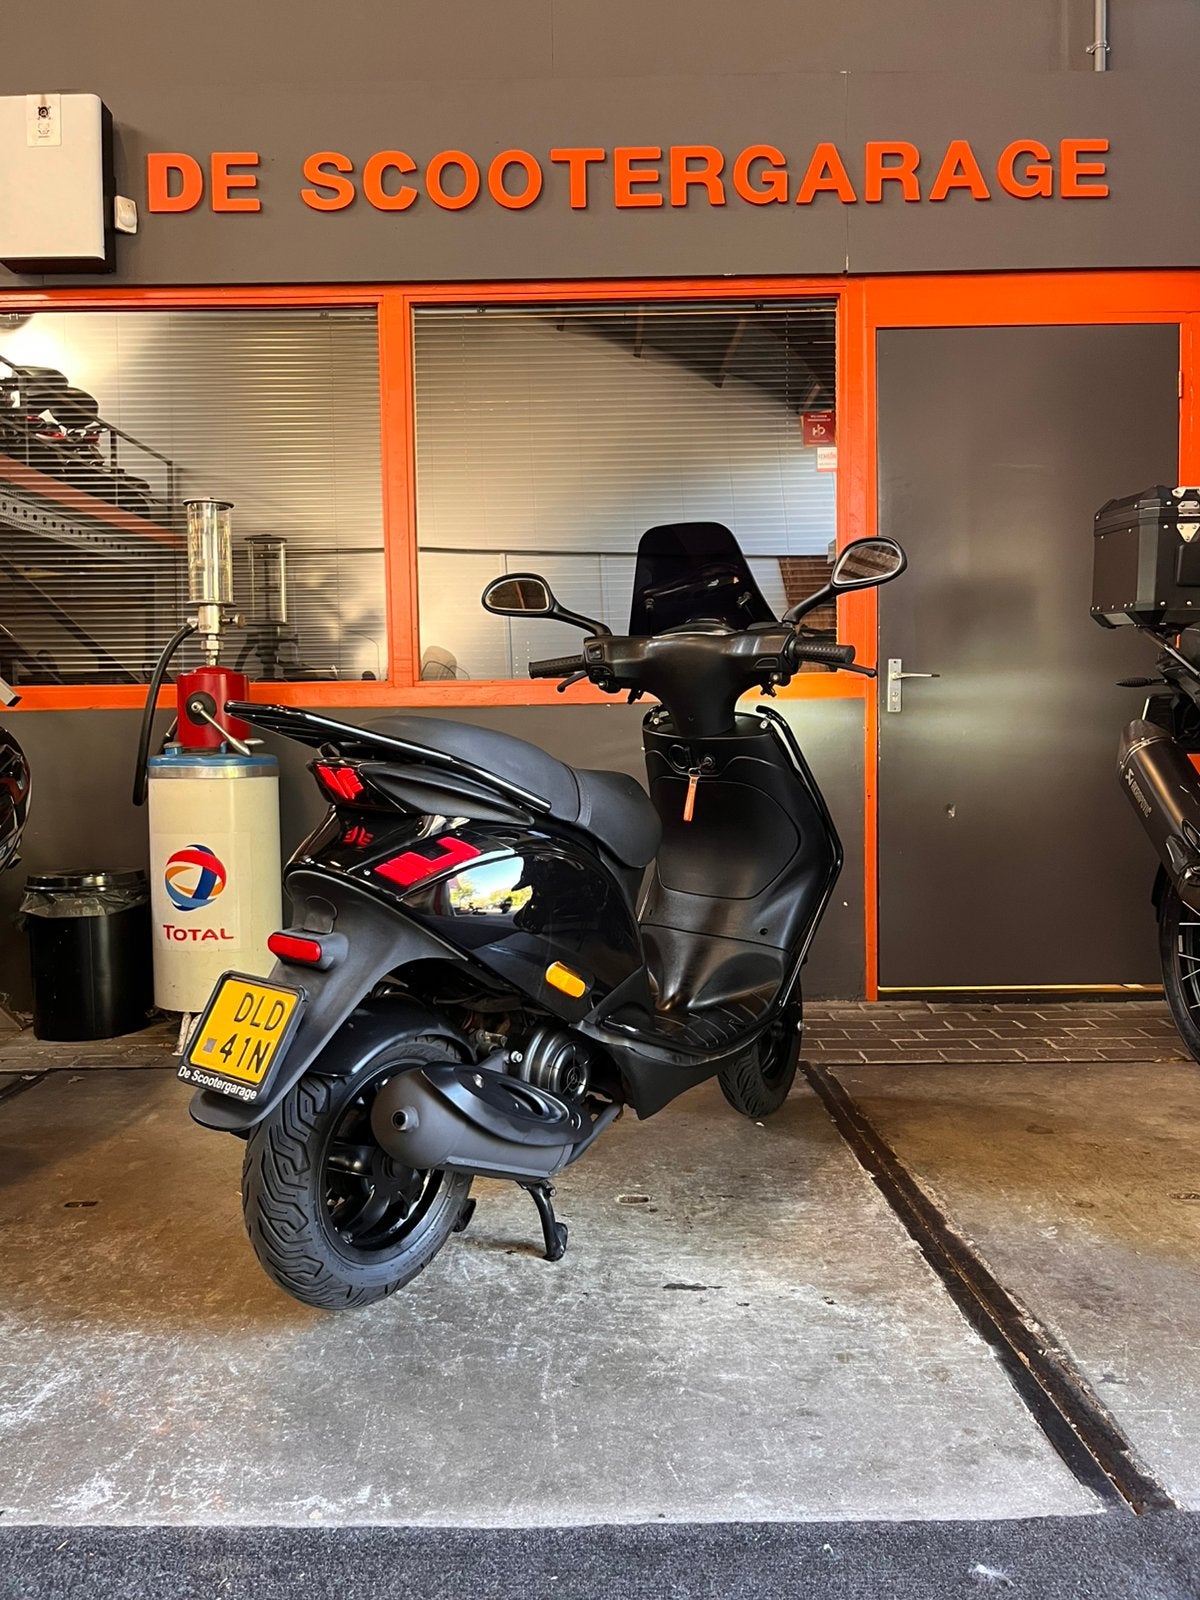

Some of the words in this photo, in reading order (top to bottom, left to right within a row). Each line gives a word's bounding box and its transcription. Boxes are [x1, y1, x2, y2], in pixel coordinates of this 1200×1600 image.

[147, 152, 261, 213] DE
[300, 138, 1109, 211] SCOOTERGARAGE
[233, 992, 286, 1031] DLD
[219, 1033, 271, 1074] 41N
[177, 1065, 191, 1079] De
[191, 1070, 258, 1100] Scootergarage
